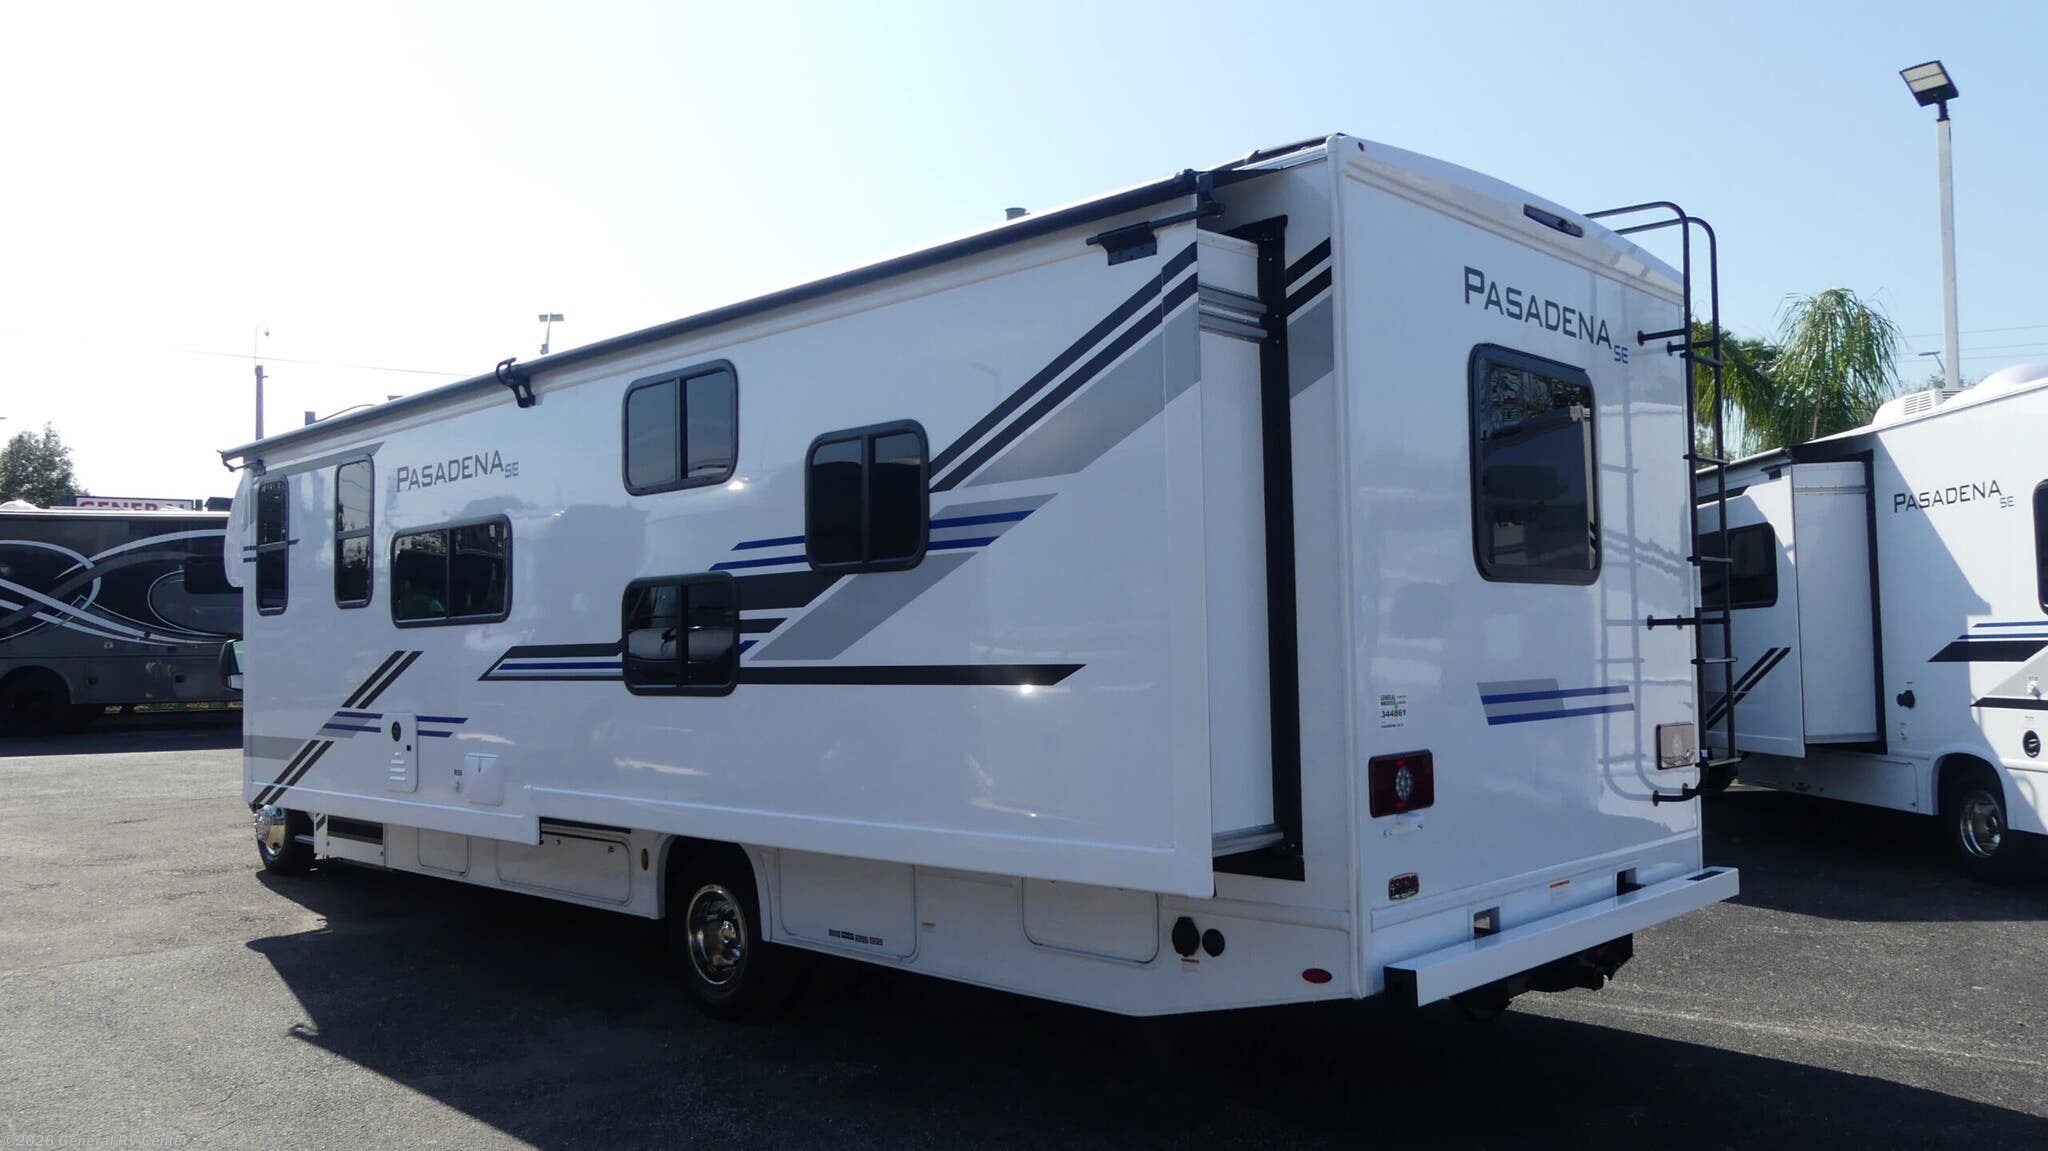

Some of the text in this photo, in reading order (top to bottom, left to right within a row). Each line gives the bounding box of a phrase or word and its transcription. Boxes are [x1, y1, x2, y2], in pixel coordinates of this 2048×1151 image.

[1464, 266, 1629, 364] PASADENA SE
[397, 450, 519, 492] PASADENA SE
[1893, 480, 2014, 513] PASADENA SE
